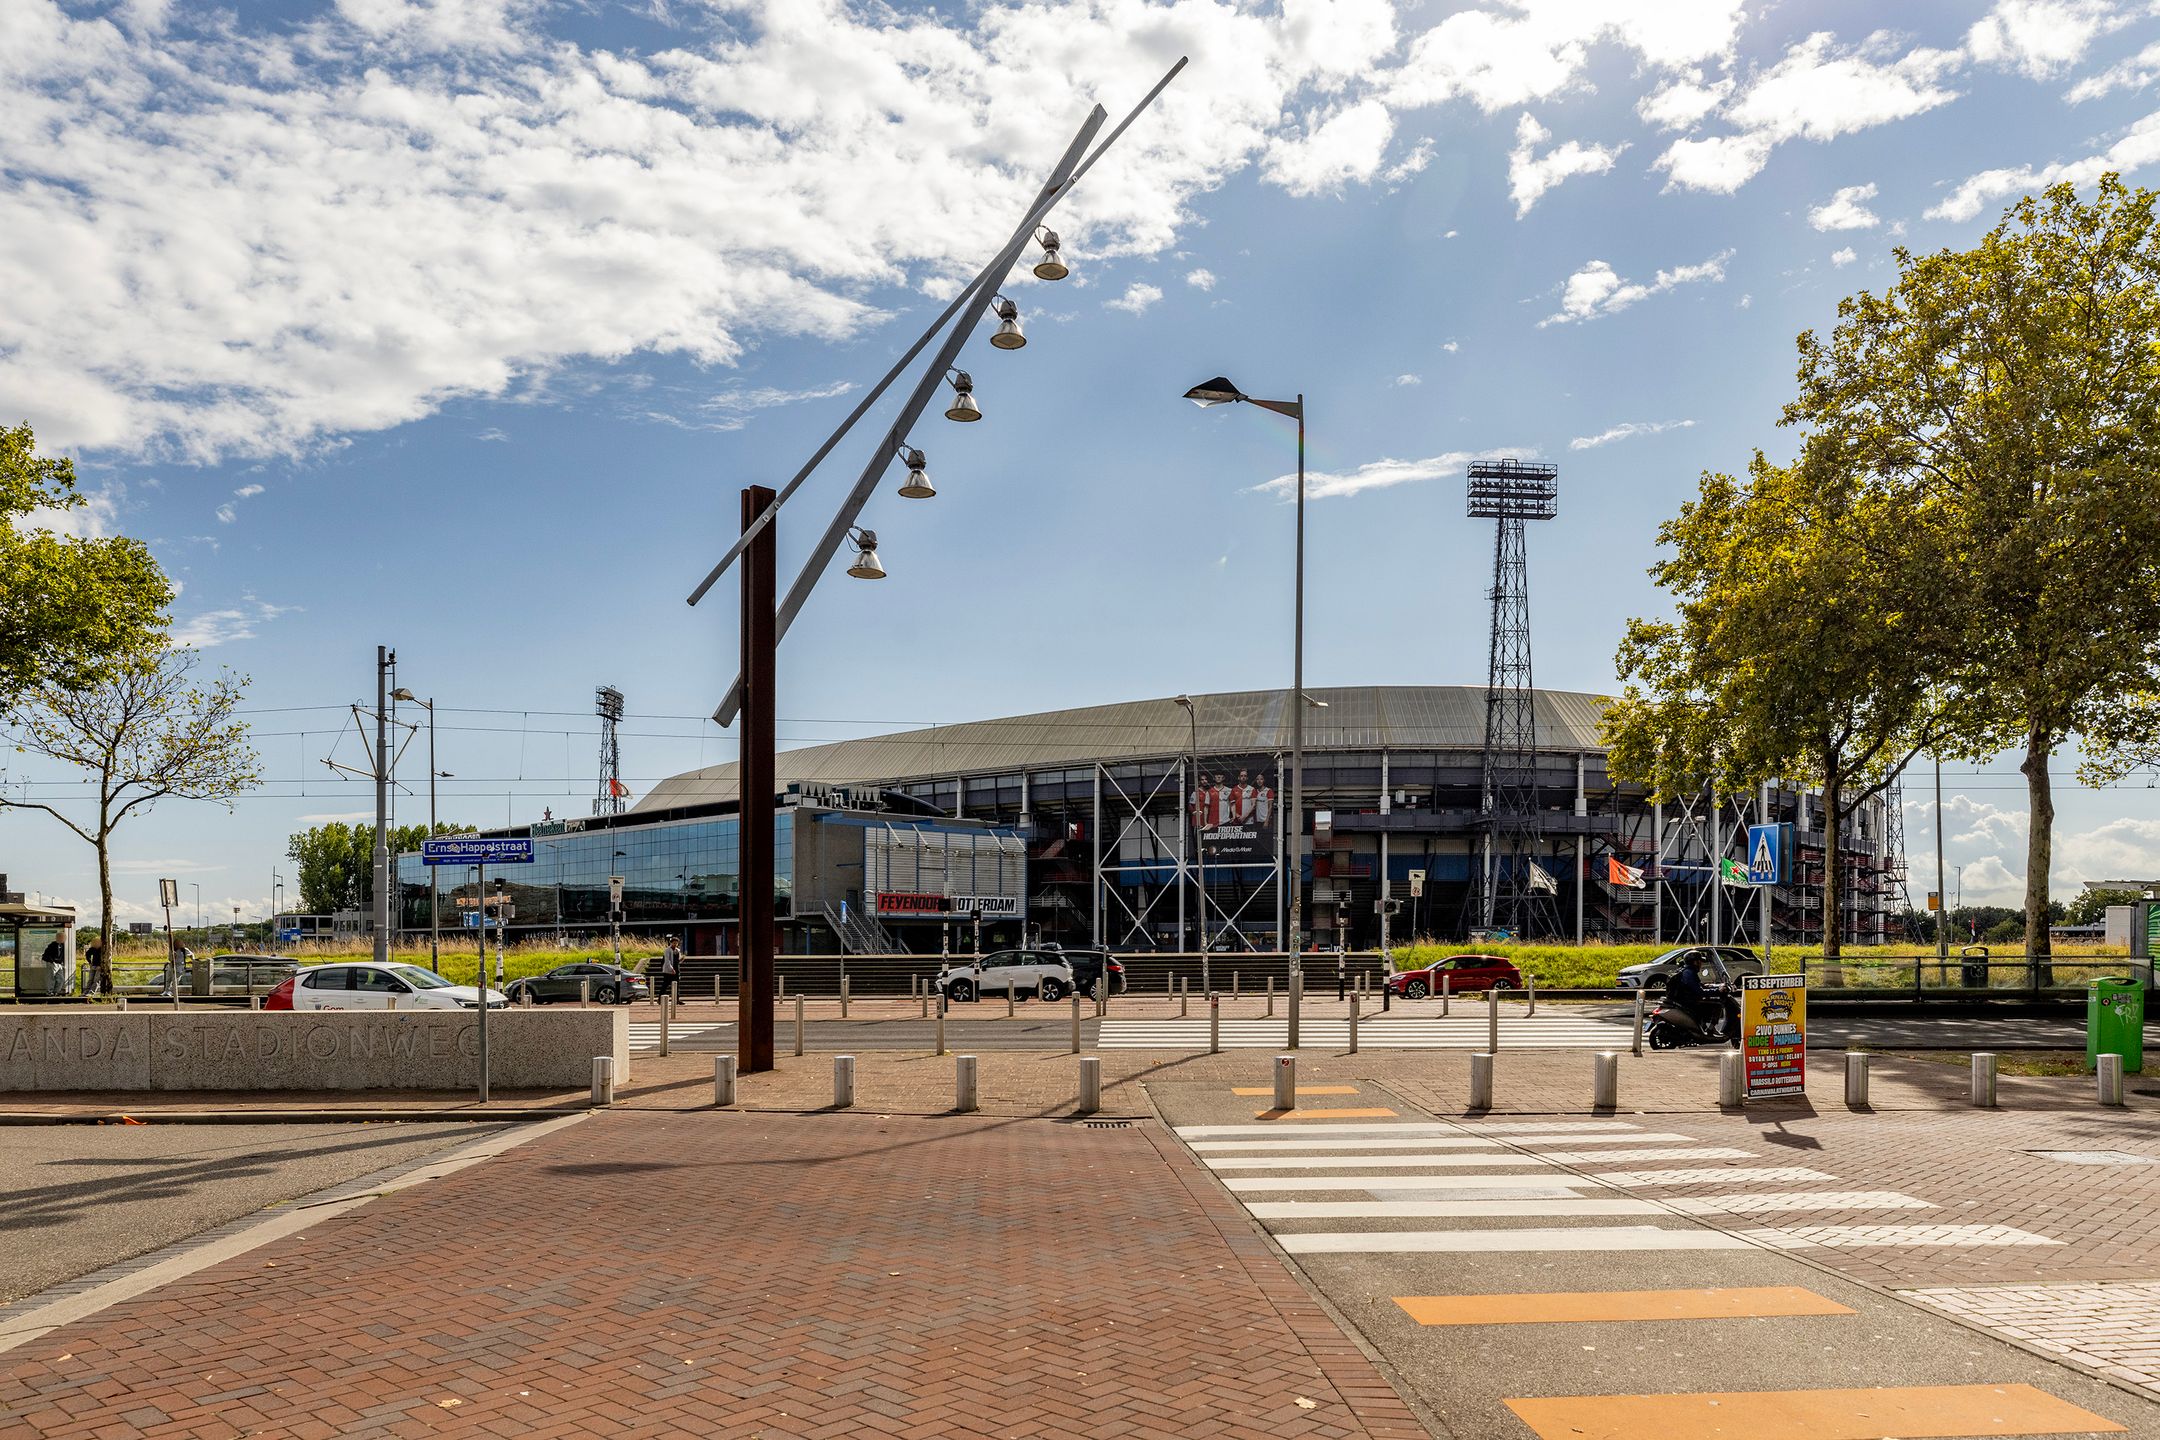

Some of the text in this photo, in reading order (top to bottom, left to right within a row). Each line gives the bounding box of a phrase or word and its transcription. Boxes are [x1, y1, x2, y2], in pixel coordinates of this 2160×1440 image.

[1203, 832, 1257, 840] HOOFDPARTNER
[428, 841, 527, 854] Erns Happelstraat
[953, 898, 1015, 912] OTTERDAM
[1747, 977, 1804, 989] 13 SEPTEMBER
[1756, 1025, 1772, 1036] 2WO
[165, 1025, 481, 1061] STADIONWEG
[1748, 1036, 1769, 1047] RIDGE
